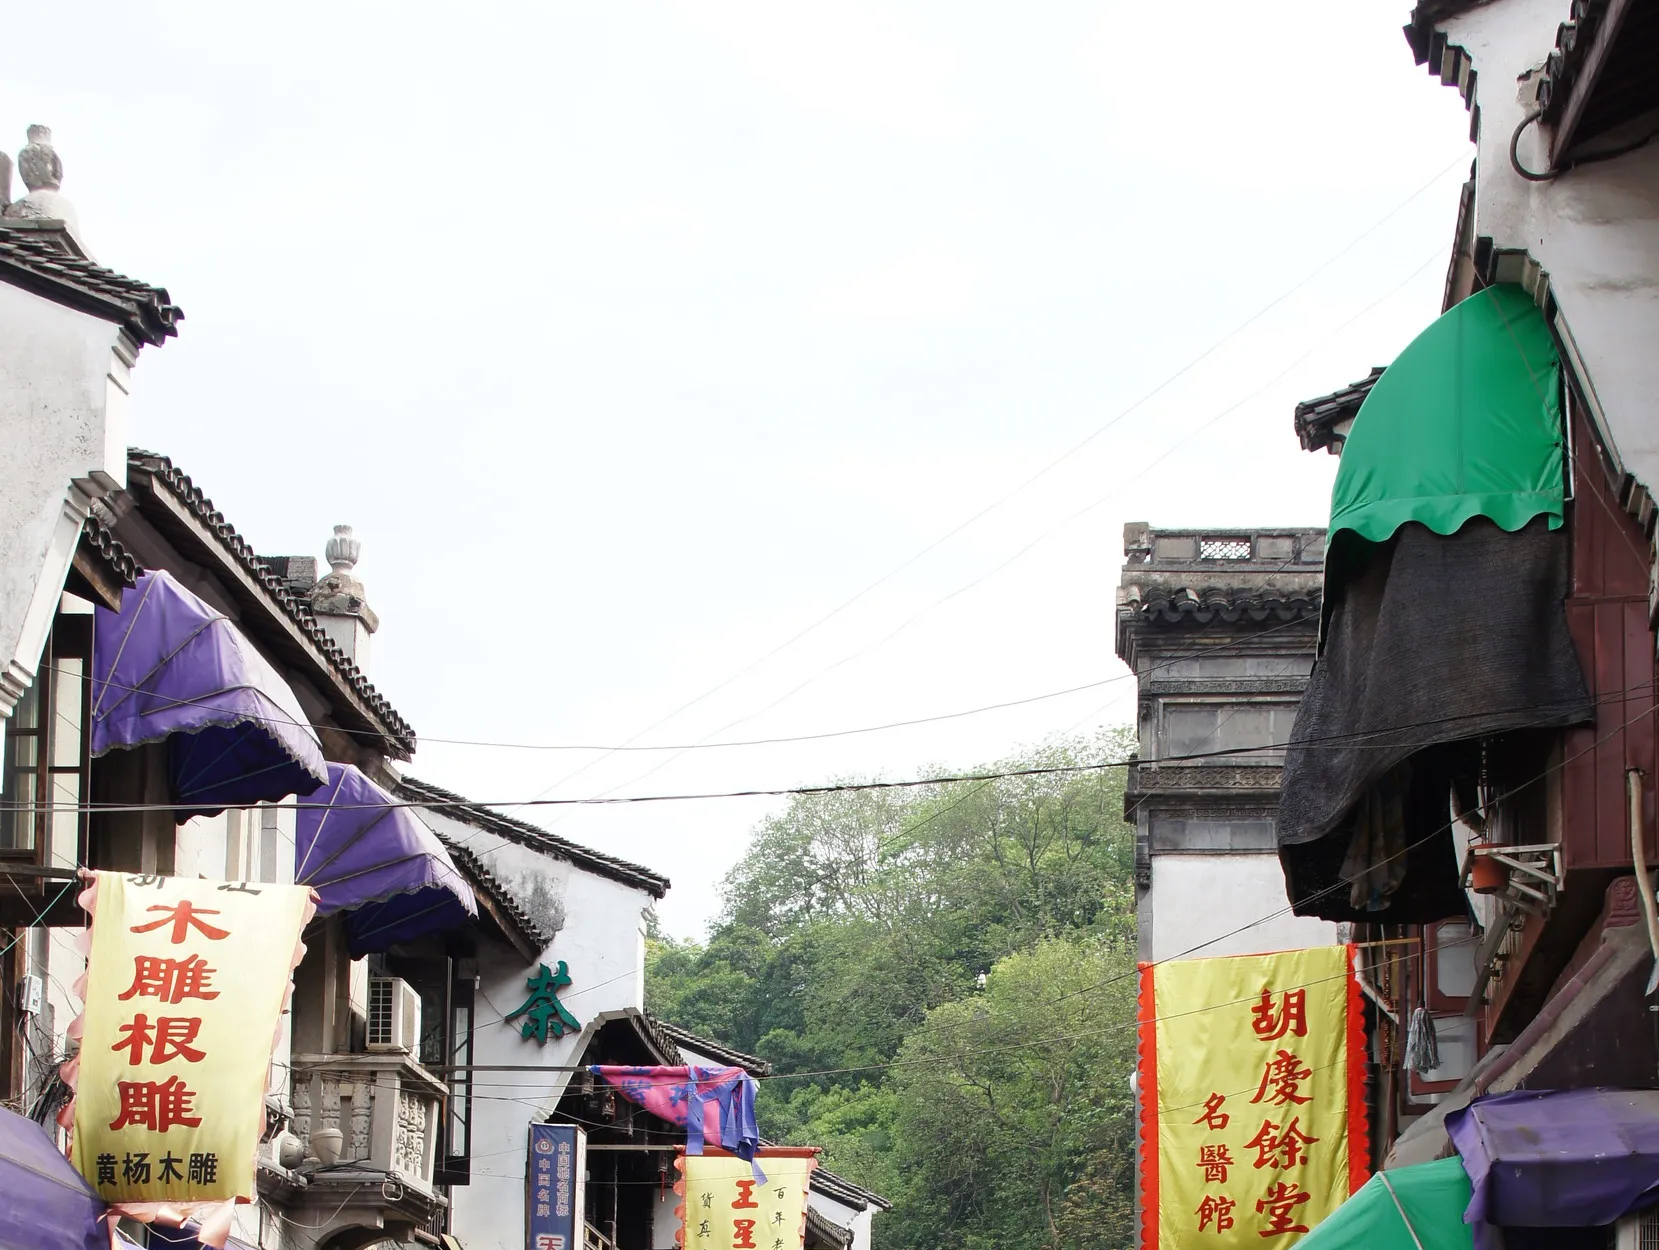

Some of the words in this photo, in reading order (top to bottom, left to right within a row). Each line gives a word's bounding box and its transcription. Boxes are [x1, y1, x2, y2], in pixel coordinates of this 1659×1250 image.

[109, 899, 232, 1133] 木雕根雕
[505, 961, 582, 1044] 茶
[1192, 1092, 1237, 1235] 名醫館
[1243, 987, 1320, 1238] 胡慶餘堂
[95, 1152, 219, 1187] 黄杨木雕
[536, 1158, 551, 1218] 中国名牌
